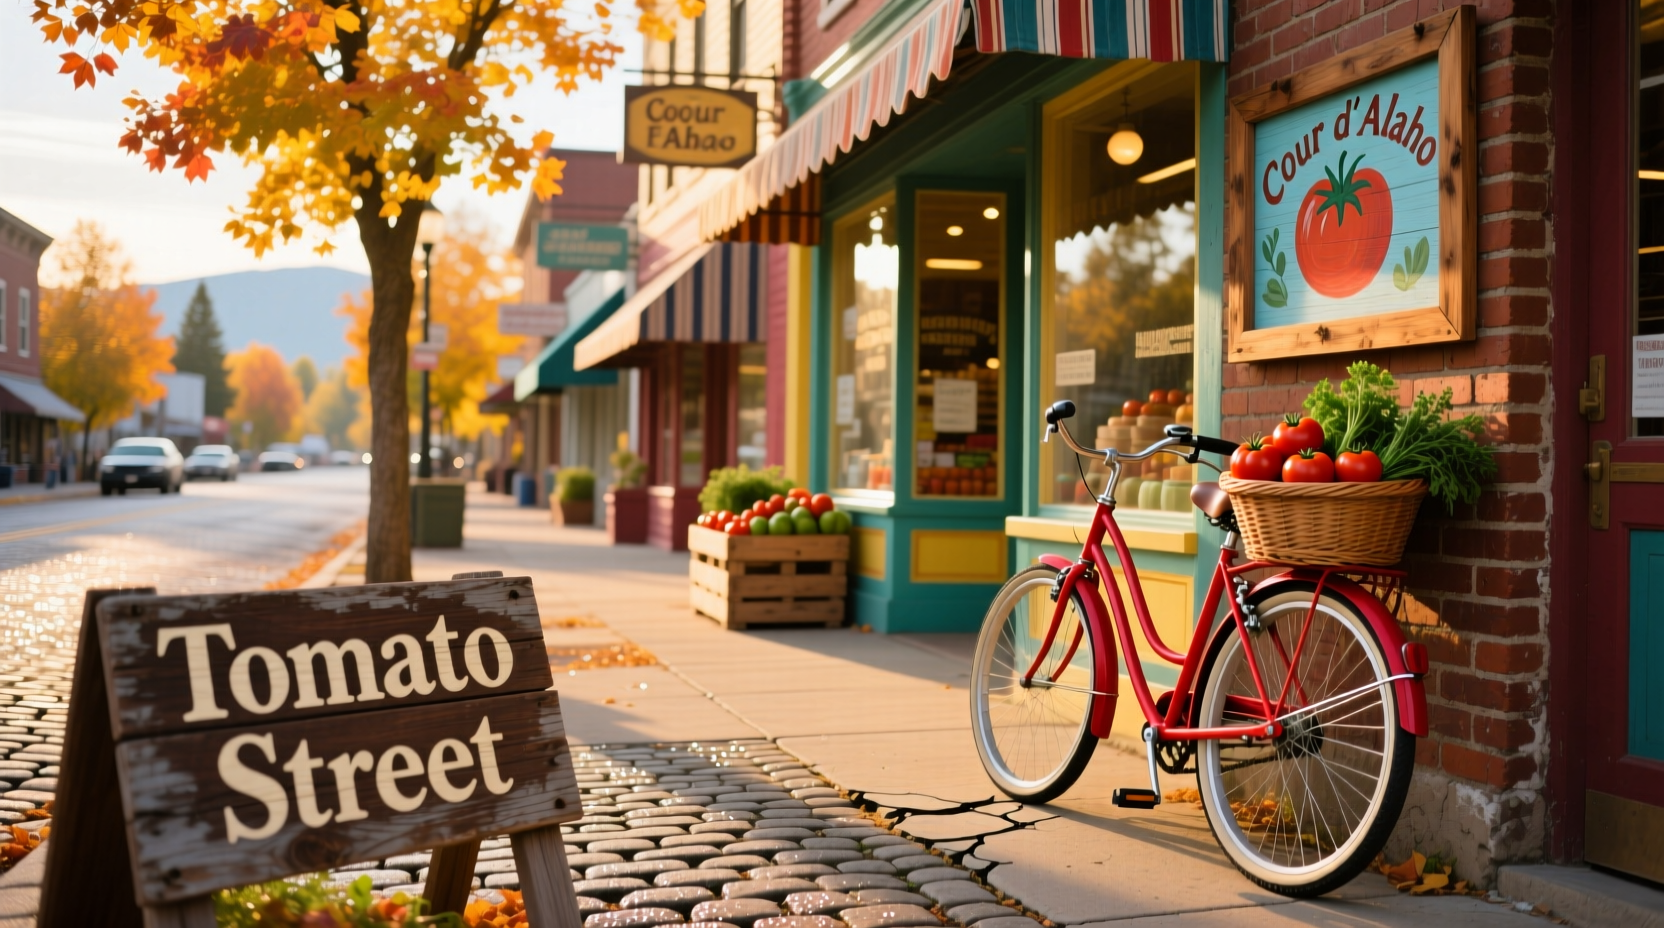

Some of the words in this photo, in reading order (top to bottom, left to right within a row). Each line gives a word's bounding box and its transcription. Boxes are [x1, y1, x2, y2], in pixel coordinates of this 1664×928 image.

[646, 97, 725, 124] Coour
[1262, 121, 1325, 205] Cour
[1333, 92, 1437, 166] d'Alaho
[156, 614, 514, 724] Tomato
[217, 715, 515, 845] Street
